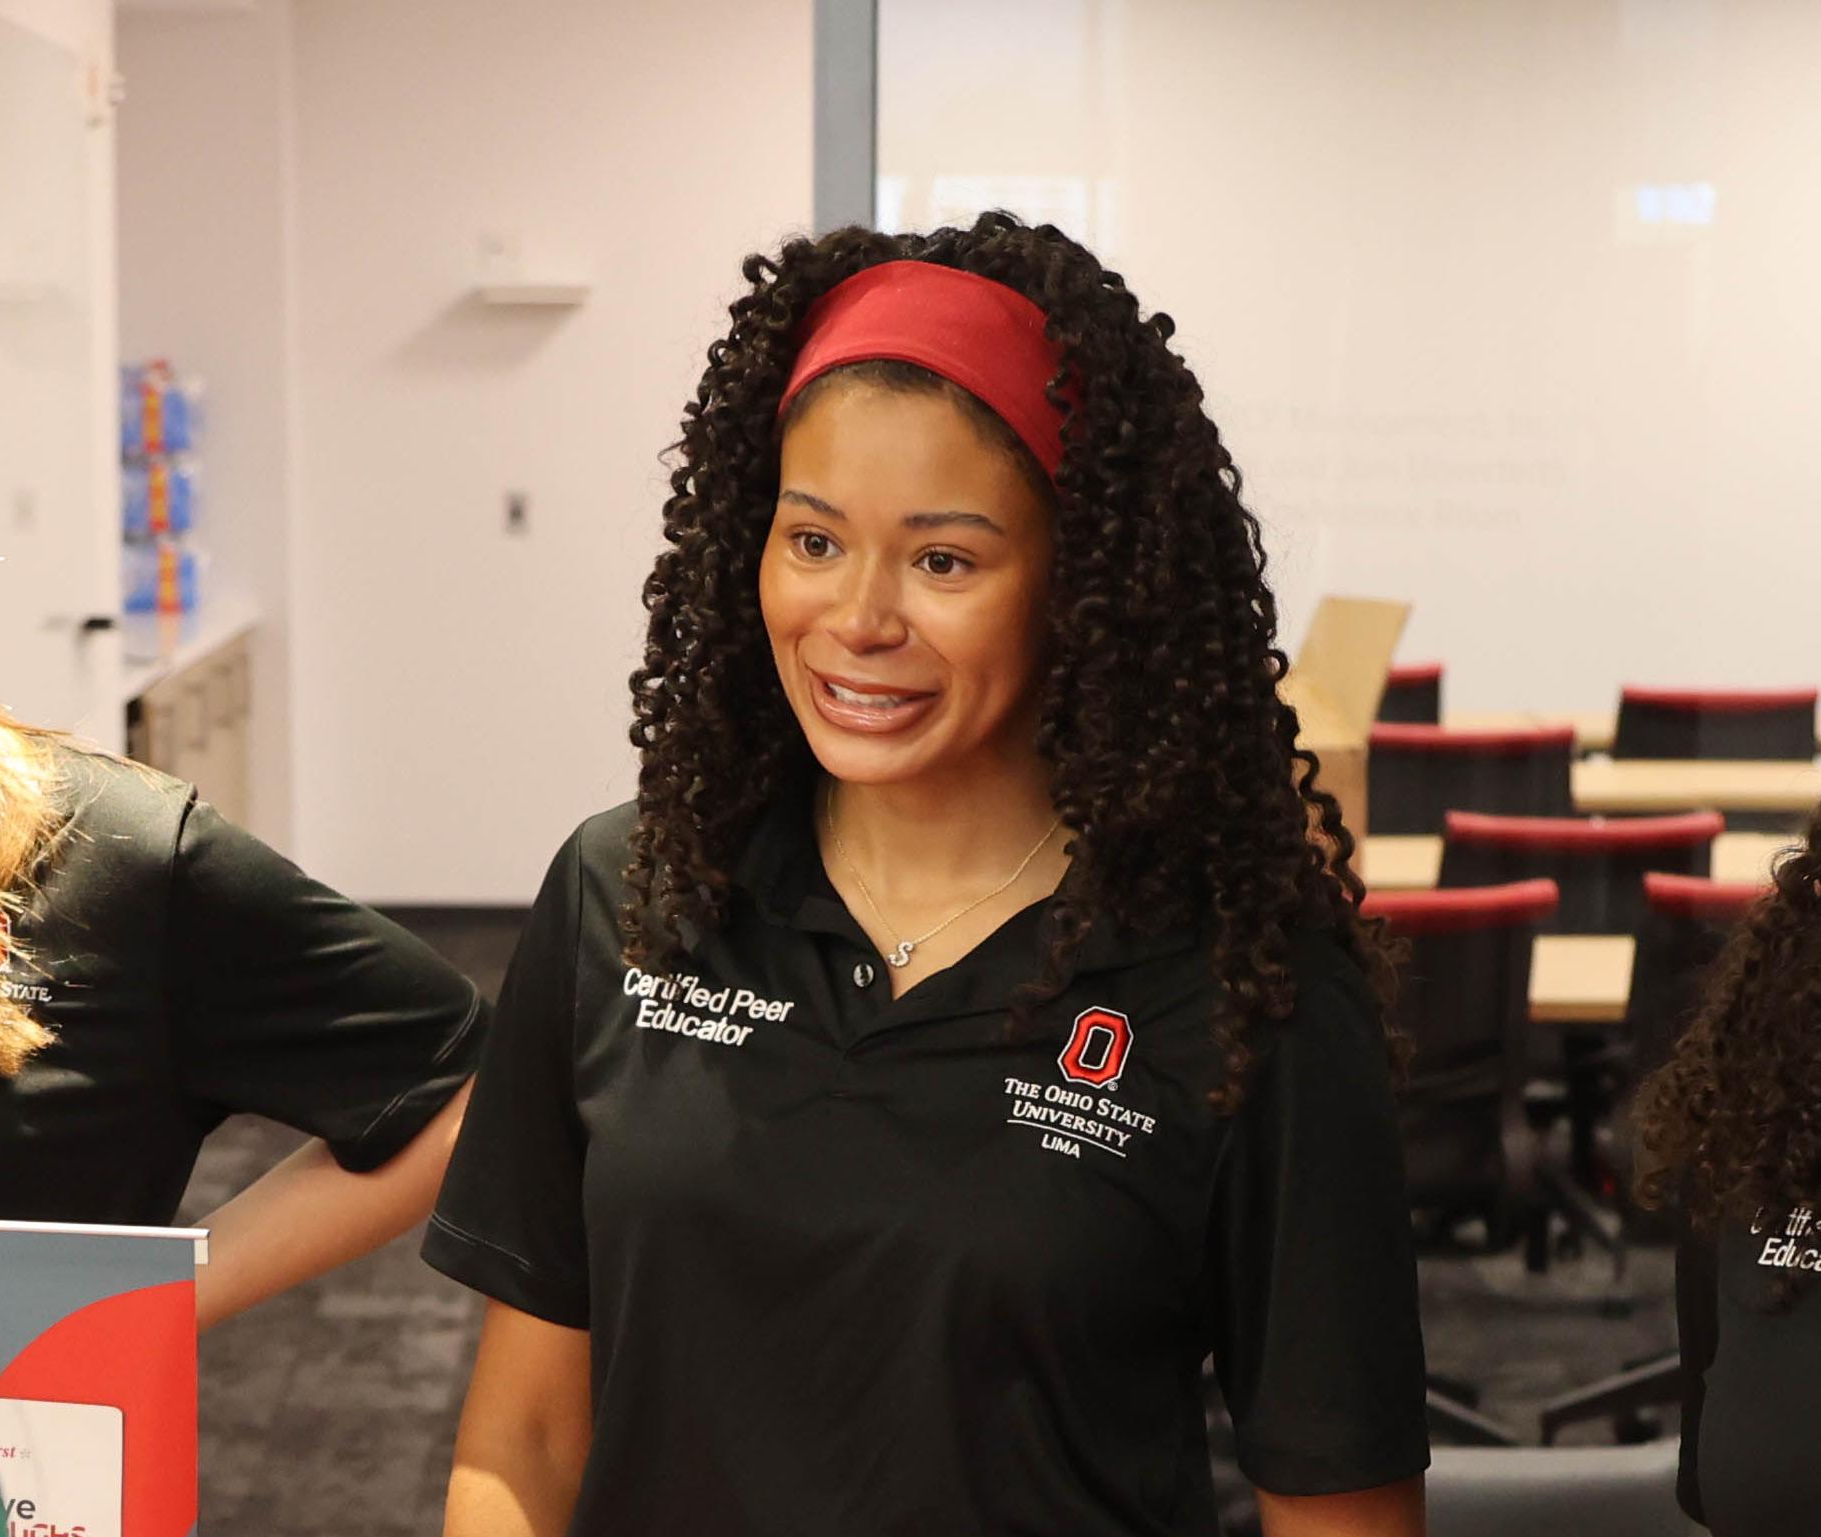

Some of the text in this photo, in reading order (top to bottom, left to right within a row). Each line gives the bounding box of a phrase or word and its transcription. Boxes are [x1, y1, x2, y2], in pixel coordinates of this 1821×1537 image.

[636, 999, 753, 1046] Educator
[729, 990, 794, 1022] Peer
[1004, 1076, 1156, 1134] THE OHIO STATE
[1011, 1099, 1132, 1149] UNIVERSITY
[1041, 1135, 1081, 1159] LIMA
